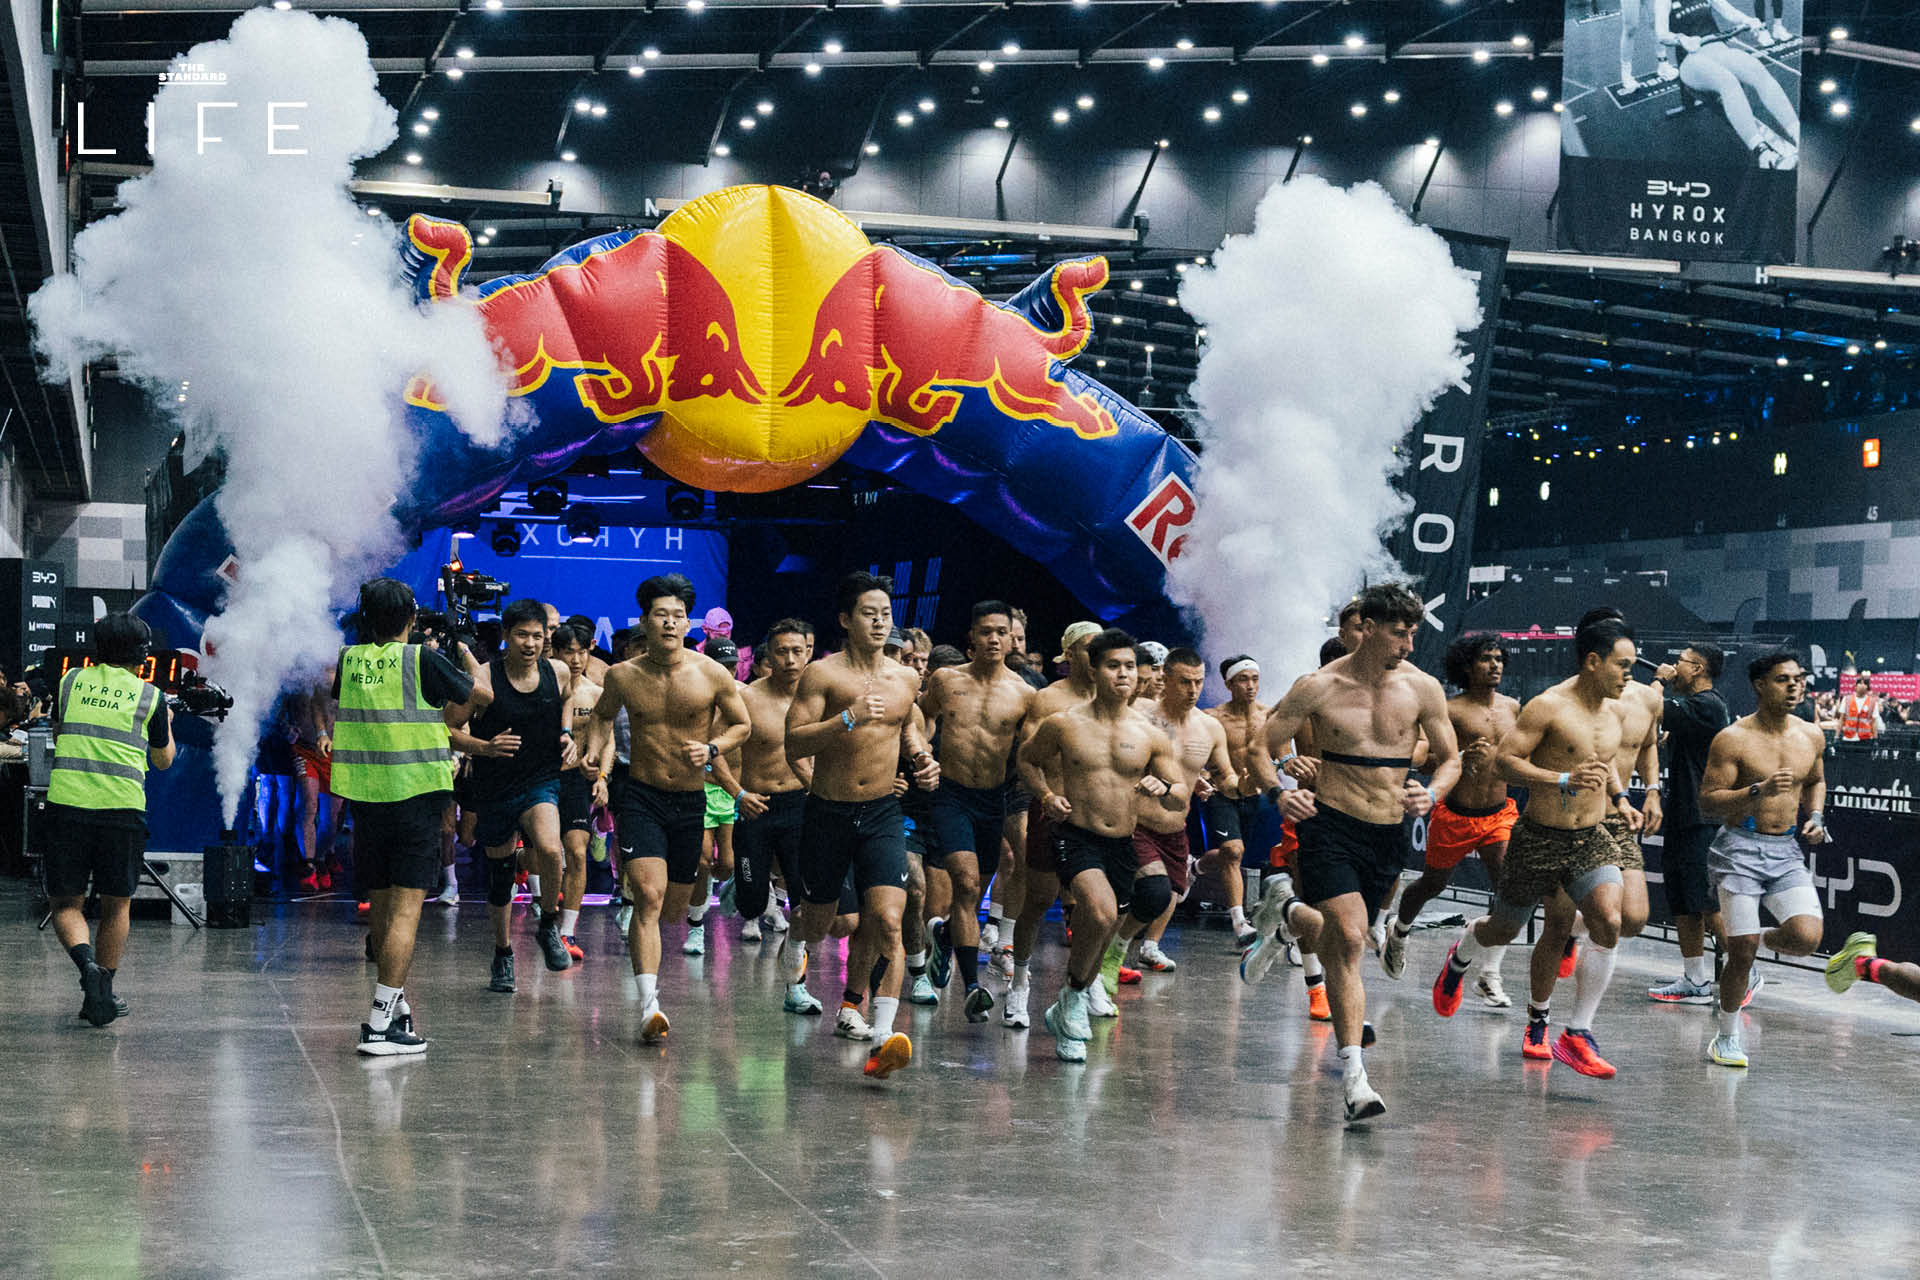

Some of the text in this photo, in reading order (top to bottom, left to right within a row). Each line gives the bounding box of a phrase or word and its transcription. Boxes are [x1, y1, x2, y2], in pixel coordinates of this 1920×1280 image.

[1647, 180, 1711, 198] BYD
[1631, 202, 1725, 223] HYROX
[1631, 227, 1724, 245] BANGKOK
[32, 571, 57, 584] BYD
[346, 655, 397, 670] HYROX
[351, 672, 384, 685] MEDIA
[75, 682, 136, 702] HYROX
[81, 696, 119, 710] MEDIA
[1834, 778, 1912, 813] amazfit
[1809, 850, 1902, 918] YD
